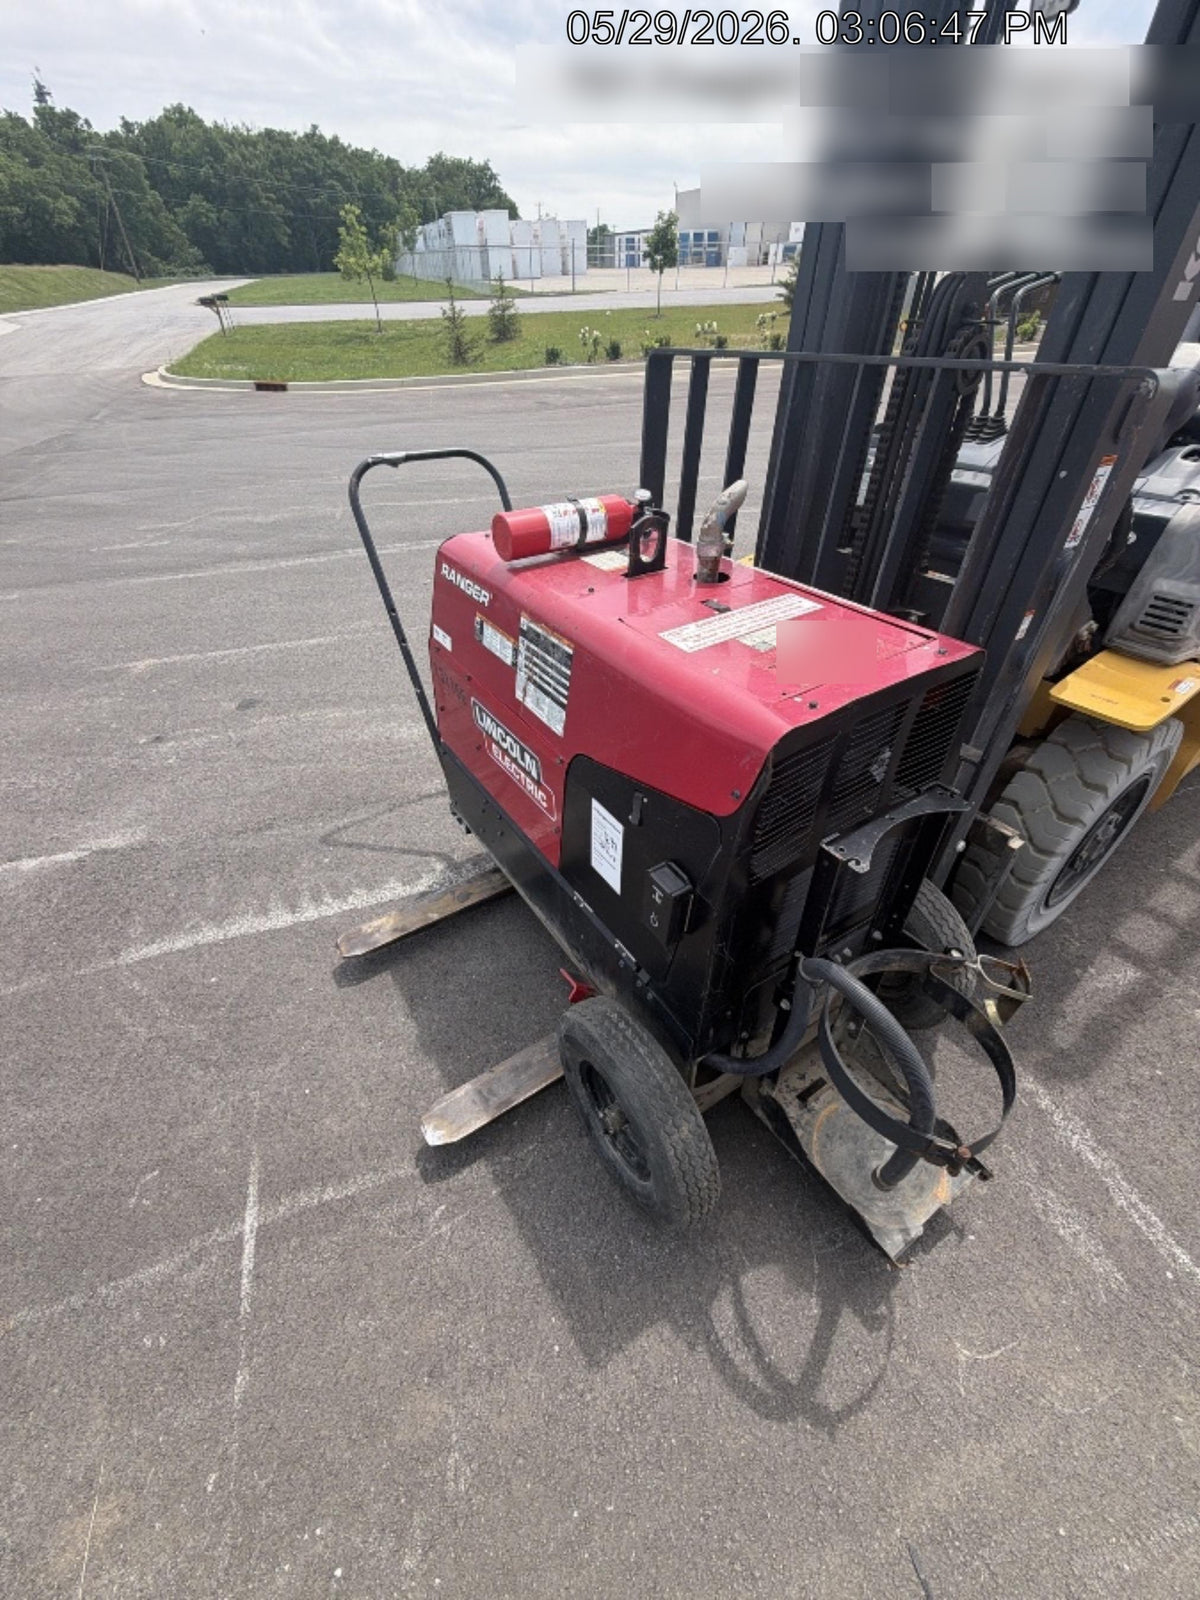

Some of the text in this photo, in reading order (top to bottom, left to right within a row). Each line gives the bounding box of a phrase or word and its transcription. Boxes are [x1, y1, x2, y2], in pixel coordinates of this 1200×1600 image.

[440, 563, 491, 607] RANGER
[475, 705, 539, 780] LINCOLN
[491, 742, 549, 809] ELECTRIC
